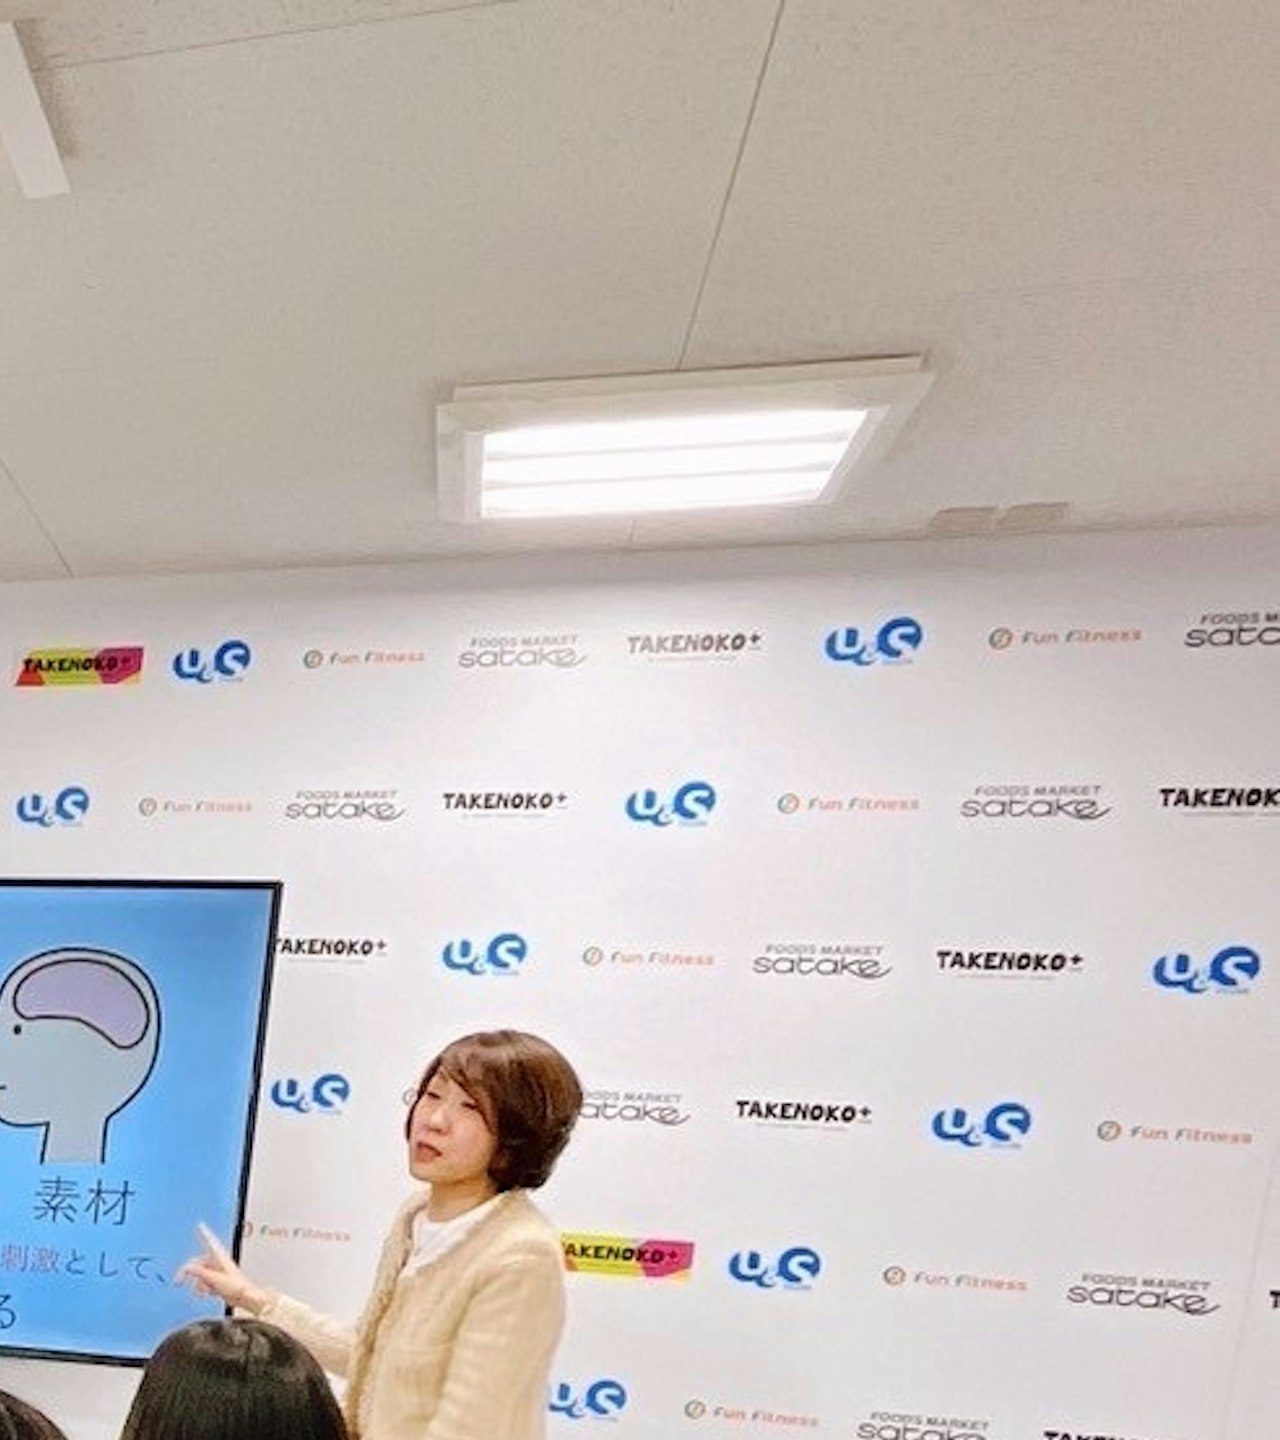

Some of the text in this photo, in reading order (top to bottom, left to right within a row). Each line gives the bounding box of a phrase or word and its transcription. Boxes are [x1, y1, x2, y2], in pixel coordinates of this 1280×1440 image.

[1021, 629, 1142, 644] Fun Fitness
[1184, 624, 1280, 648] sata
[330, 650, 425, 665] Fun Fitness
[458, 646, 589, 668] satake
[163, 801, 253, 813] Fun Fitness
[807, 796, 919, 811] Fun Fitness
[960, 797, 1112, 819] satake
[1160, 787, 1280, 808] TAKENOK
[285, 797, 406, 822] satake
[611, 951, 715, 966] Fun Fitness
[753, 955, 892, 979] satake
[583, 1090, 619, 1100] OODS
[580, 1099, 689, 1126] atake
[1130, 1126, 1252, 1144] Fun Fitness
[34, 1175, 136, 1226] 素材
[561, 1242, 677, 1264] AKENOKO+
[914, 1273, 1028, 1291] Fun Fitness
[1067, 1284, 1220, 1316] satake
[714, 1407, 820, 1427] Fun Fitness
